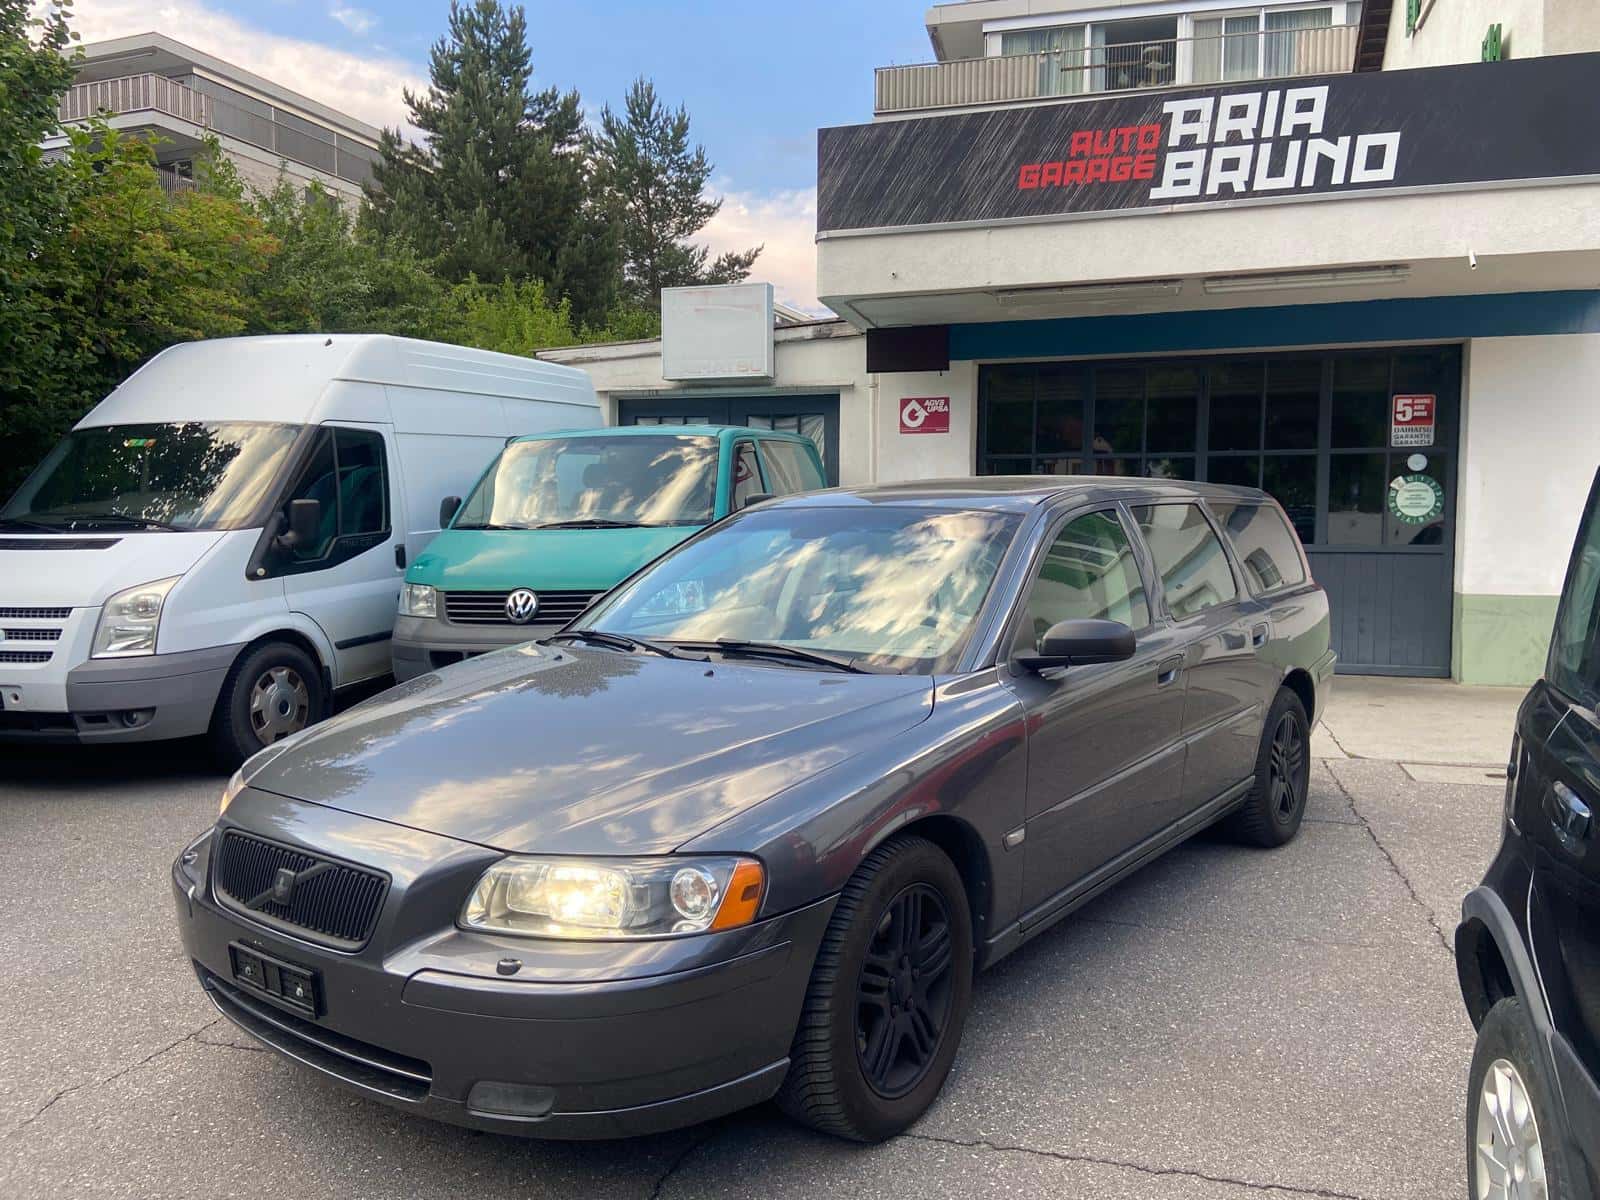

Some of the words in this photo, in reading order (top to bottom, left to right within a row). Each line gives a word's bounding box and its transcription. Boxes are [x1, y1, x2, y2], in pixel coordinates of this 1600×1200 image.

[1163, 85, 1330, 148] ARIA
[1070, 123, 1162, 158] AUTO
[1017, 154, 1157, 190] GARAGE
[1149, 131, 1401, 200] BRUNO
[1396, 398, 1412, 421] 5
